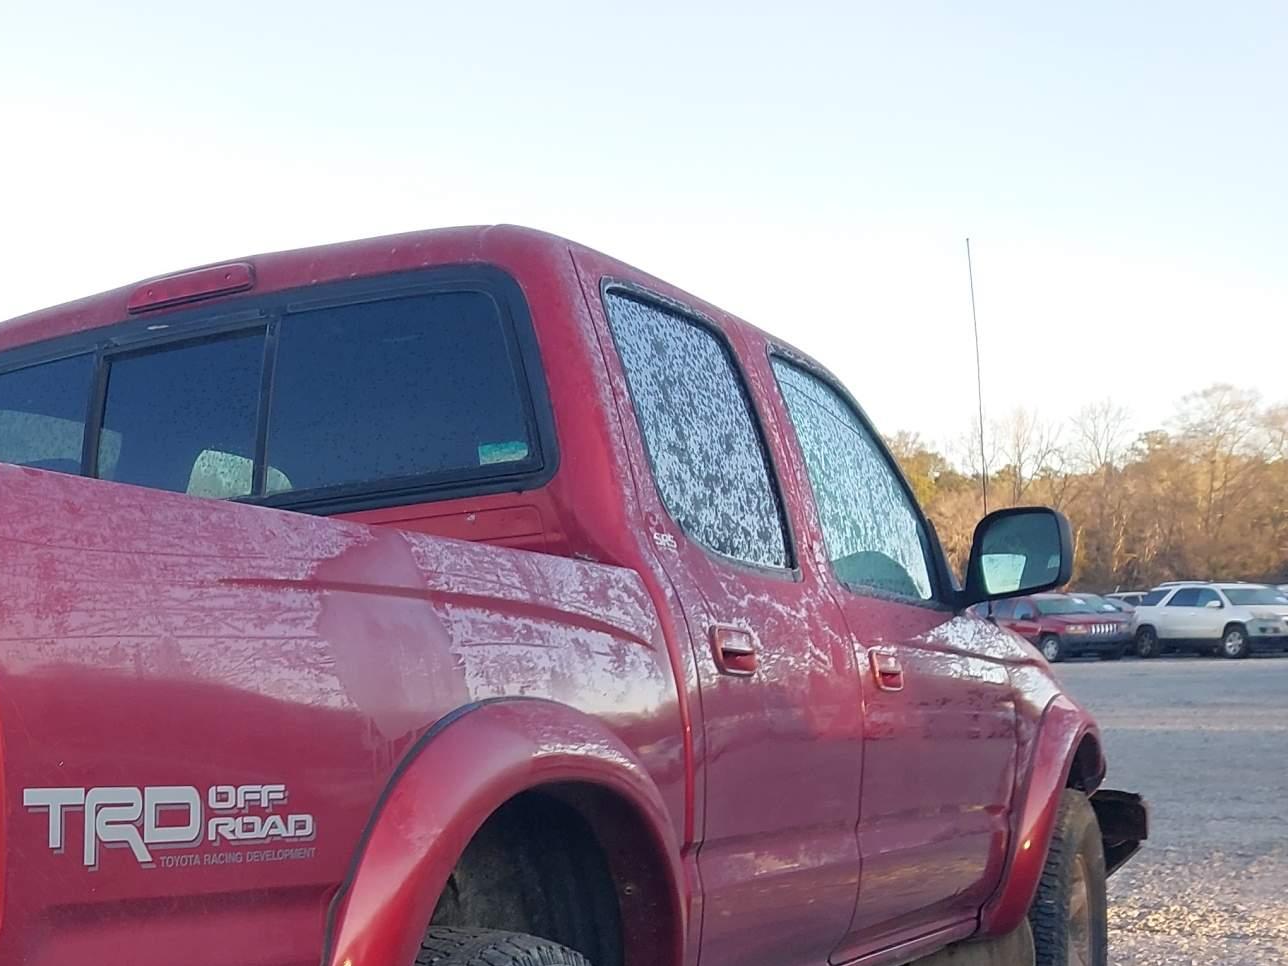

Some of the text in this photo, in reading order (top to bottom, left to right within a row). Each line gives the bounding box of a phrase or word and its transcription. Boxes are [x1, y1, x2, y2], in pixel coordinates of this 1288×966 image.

[208, 784, 288, 811] OFF
[22, 785, 204, 867] TRD
[208, 814, 315, 843] ROAD
[159, 847, 317, 868] TOYOTA RACING DEVELOPMENT
